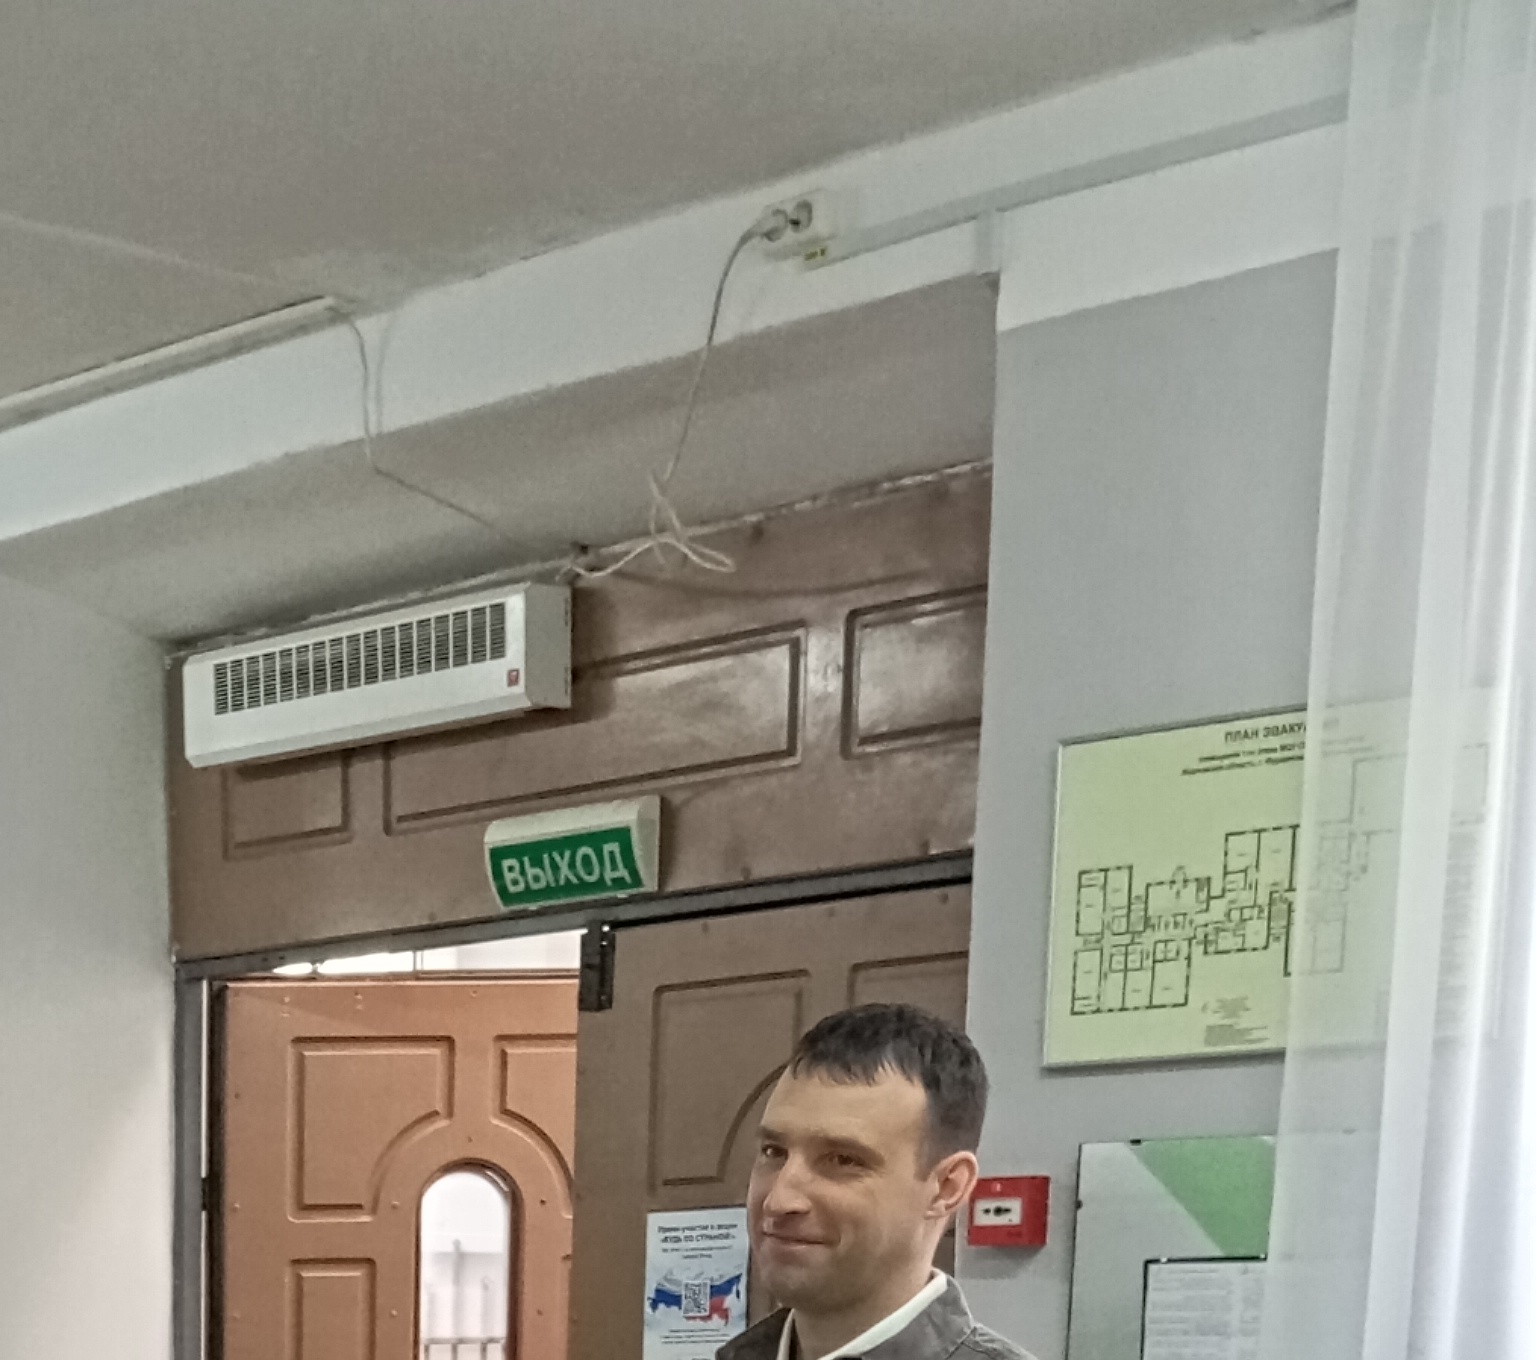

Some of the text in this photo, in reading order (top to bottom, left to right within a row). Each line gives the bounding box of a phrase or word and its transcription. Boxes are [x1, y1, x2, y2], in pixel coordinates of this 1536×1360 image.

[1224, 722, 1307, 744] ПЛАН ЭВАКУ
[501, 842, 632, 894] ВЫХОД
